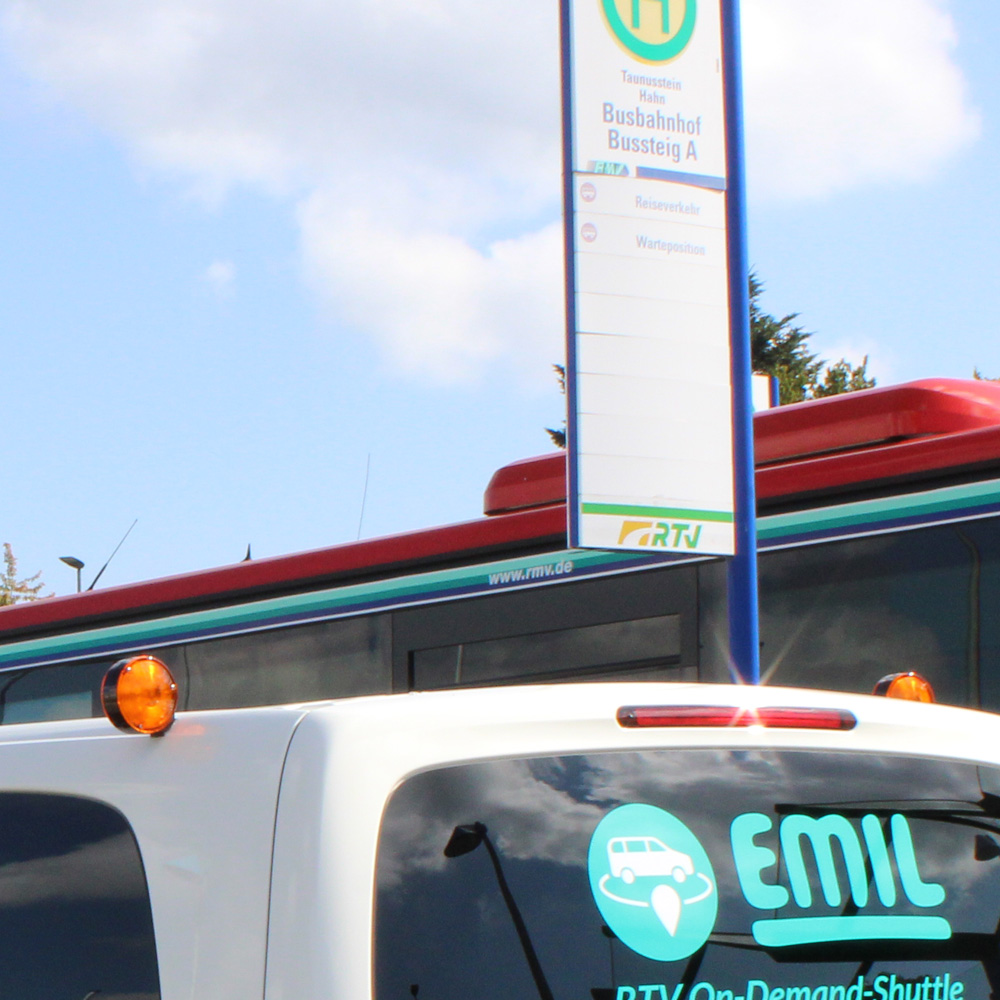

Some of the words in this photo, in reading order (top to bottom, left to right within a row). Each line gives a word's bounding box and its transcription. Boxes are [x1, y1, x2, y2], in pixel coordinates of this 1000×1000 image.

[621, 69, 682, 91] Taunusstein
[639, 89, 666, 105] Hahn
[602, 102, 702, 136] Busbahnhof
[608, 128, 681, 163] Bussteig
[686, 139, 697, 161] A
[635, 195, 701, 216] Reiseverkehr
[636, 234, 706, 257] Warteposition
[652, 522, 702, 549] RTV
[488, 559, 574, 585] www.rmv.de
[730, 812, 946, 910] EMIL
